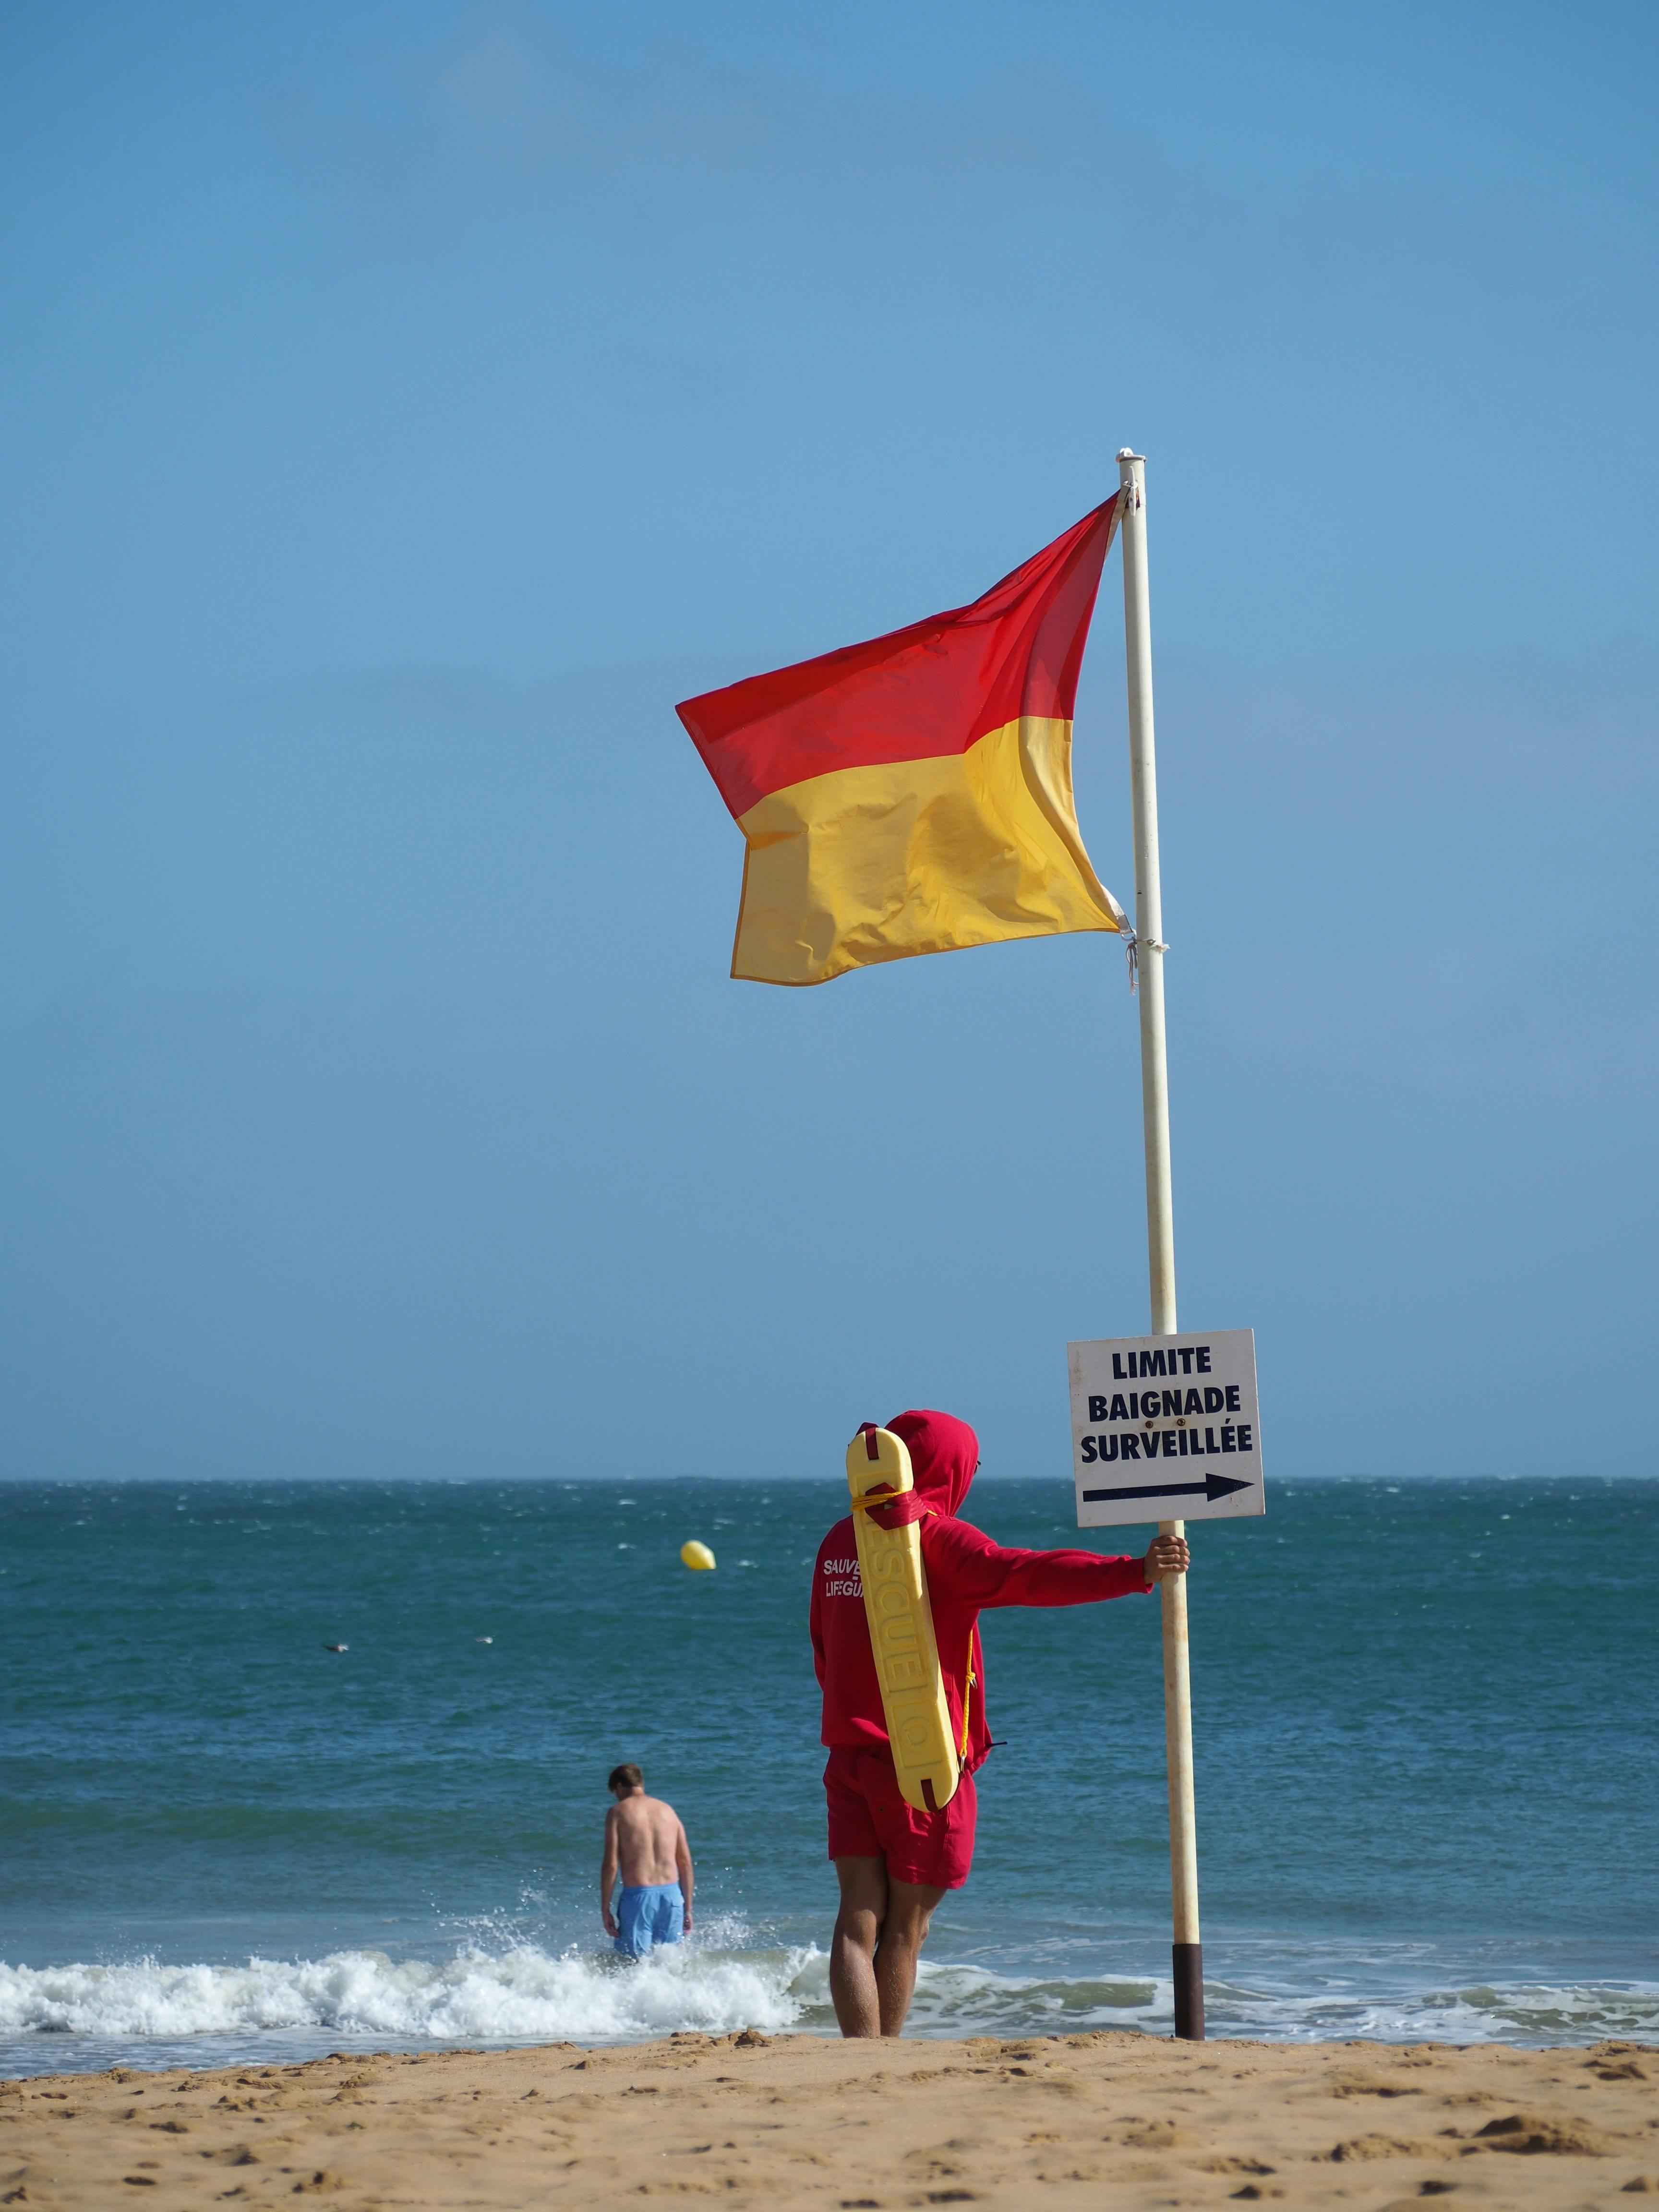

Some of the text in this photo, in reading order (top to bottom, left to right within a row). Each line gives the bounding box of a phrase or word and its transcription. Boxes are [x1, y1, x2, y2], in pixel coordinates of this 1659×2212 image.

[1112, 1346, 1212, 1380] LIMITE
[1088, 1385, 1241, 1422] BAIGNADE
[1081, 1418, 1253, 1463] SURVEILLÉE
[823, 1559, 861, 1575] SAUVE
[826, 1580, 864, 1598] LIFEGU
[866, 1521, 923, 1680] ESCUE
